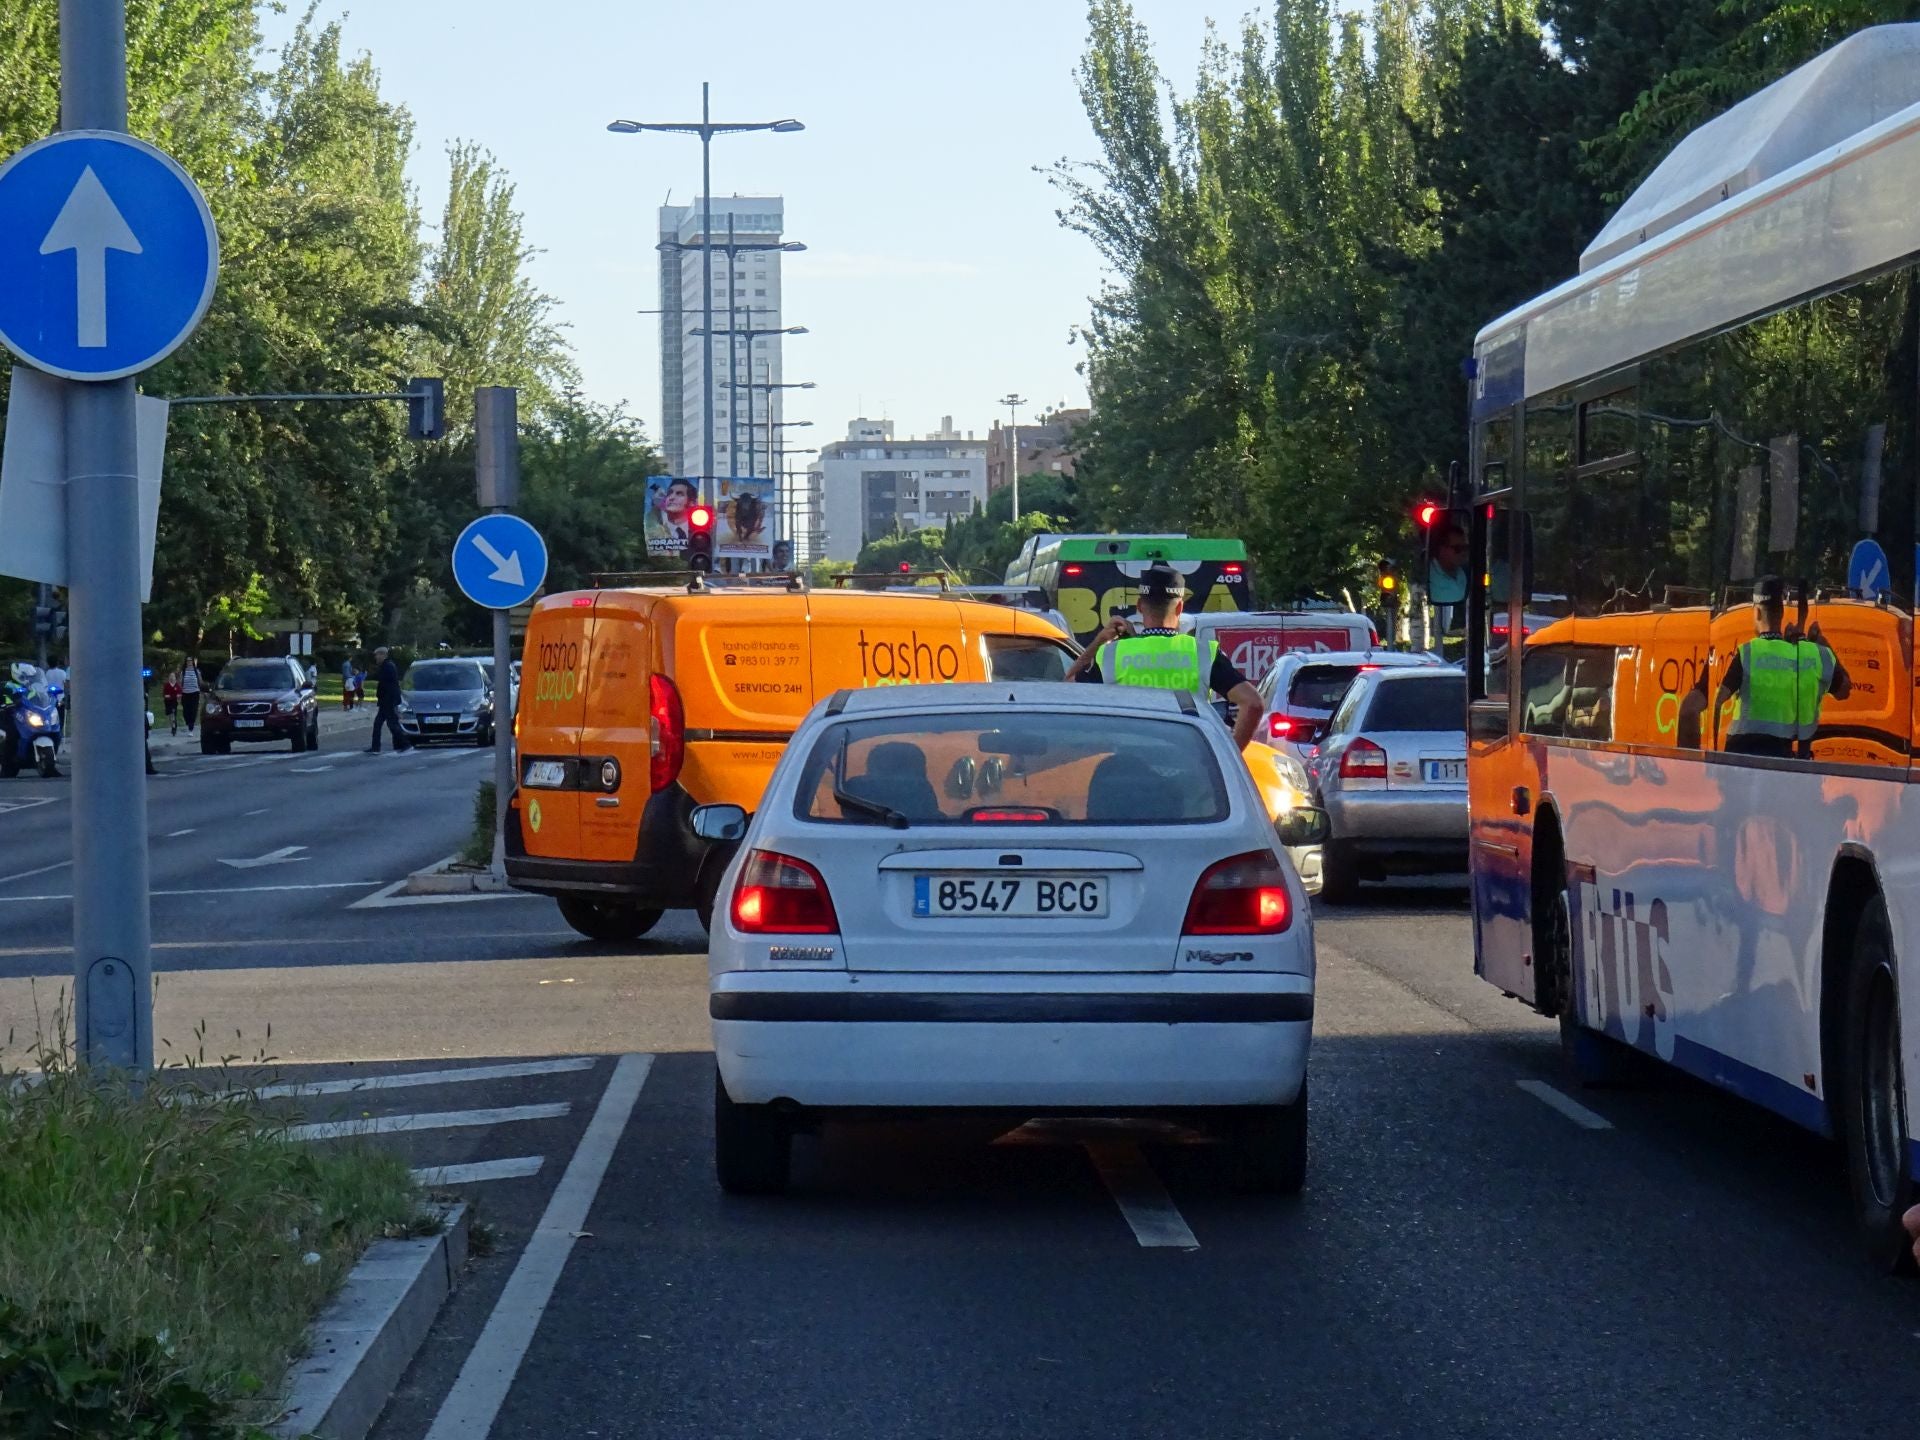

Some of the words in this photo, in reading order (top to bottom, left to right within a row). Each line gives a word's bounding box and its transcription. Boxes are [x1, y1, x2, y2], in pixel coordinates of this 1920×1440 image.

[1216, 574, 1243, 584] 409
[540, 634, 578, 672] tasho
[858, 629, 959, 680] tasho
[740, 656, 758, 666] 983
[760, 656, 770, 666] 01
[774, 656, 786, 666] 39
[788, 656, 800, 666] 77
[734, 683, 782, 693] SERVICIO
[784, 684, 802, 693] 24H
[938, 880, 1020, 912] 8547
[1037, 881, 1099, 912] BCG
[769, 946, 834, 960] RENAULT
